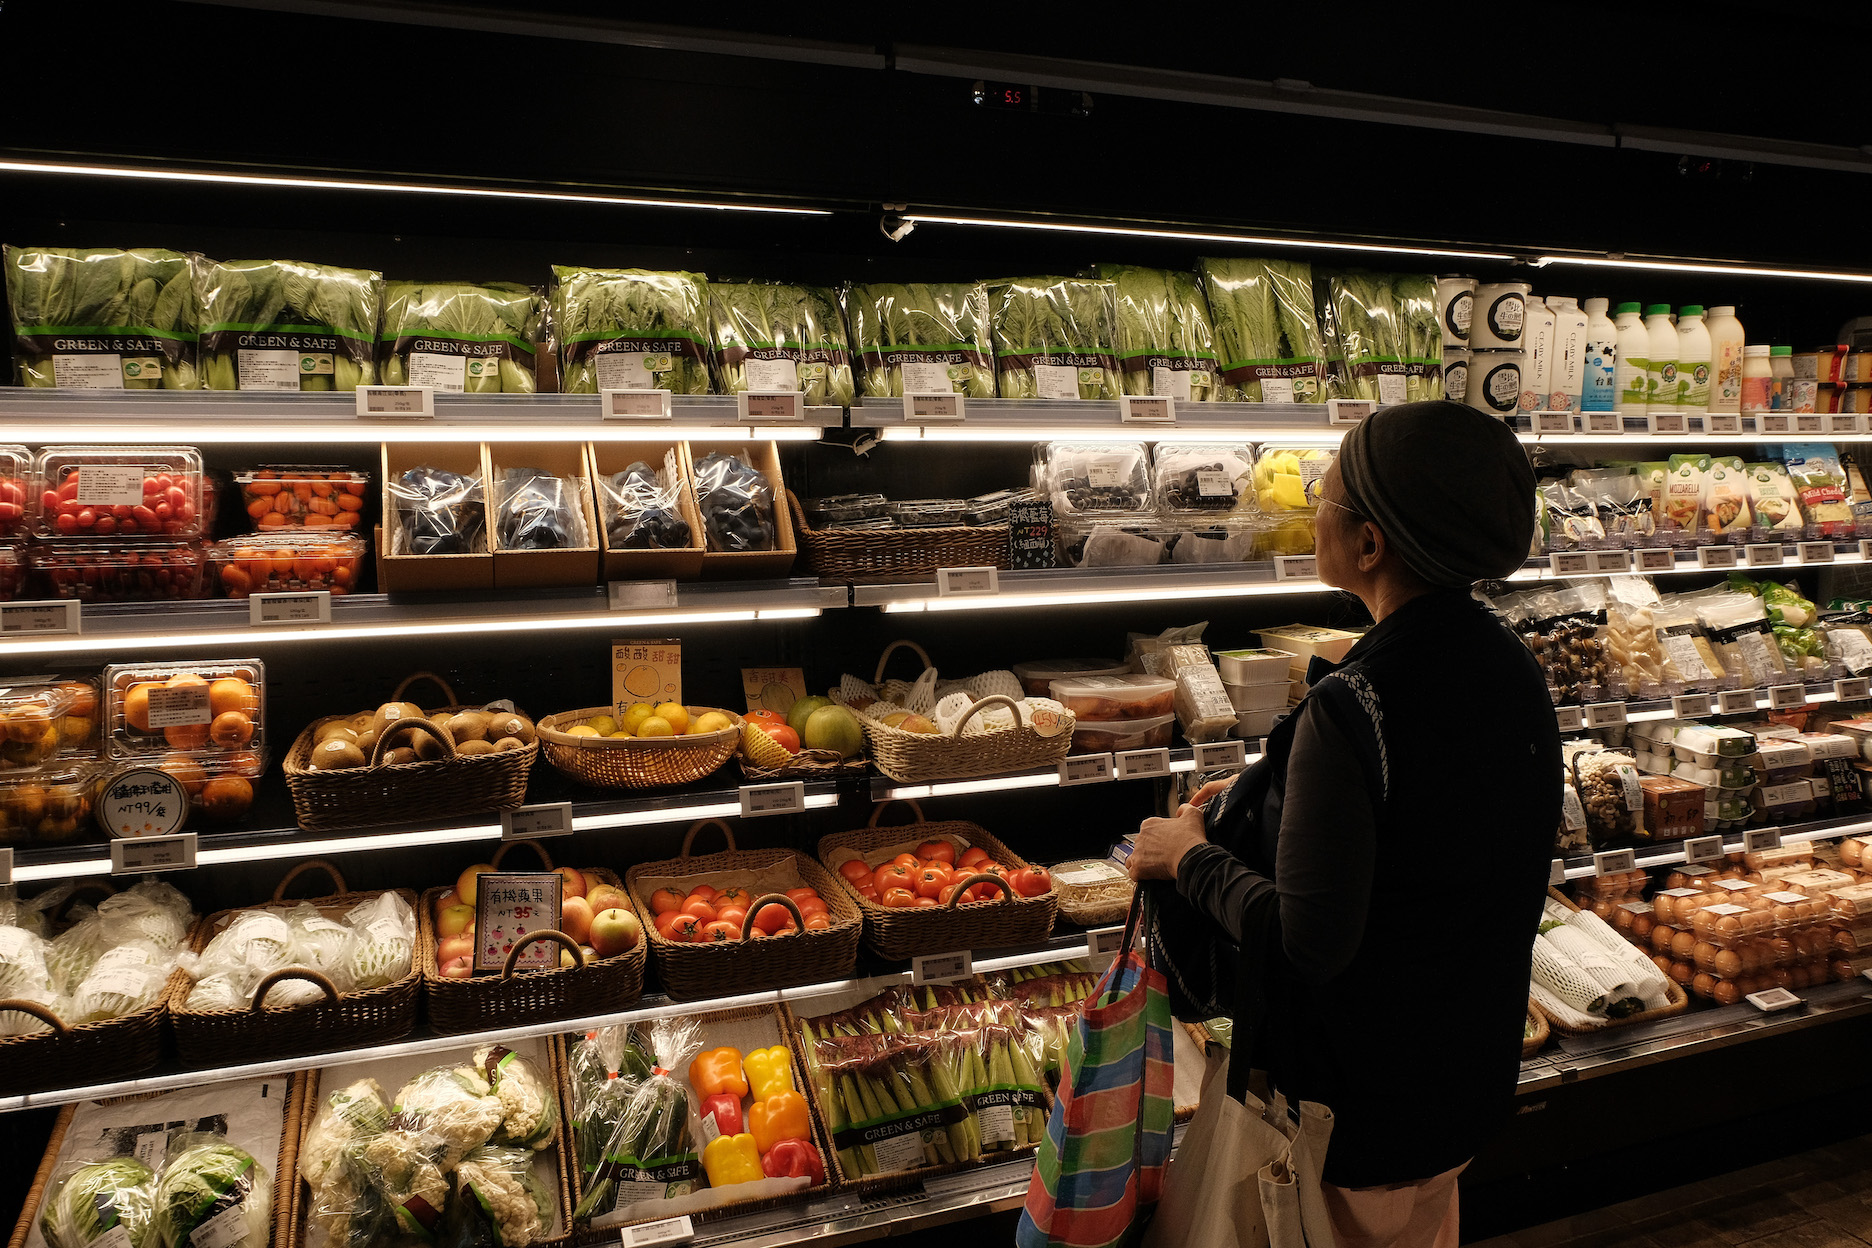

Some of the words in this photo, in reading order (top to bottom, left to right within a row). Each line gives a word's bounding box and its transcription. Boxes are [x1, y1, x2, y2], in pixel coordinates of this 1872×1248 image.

[1005, 90, 1021, 103] 5.5
[54, 339, 109, 351] GREEN
[112, 339, 123, 351] &
[125, 339, 163, 351] SAFE
[238, 335, 285, 348] GREEN
[287, 336, 300, 349] &
[302, 336, 337, 350] SAFE
[414, 340, 459, 353] GREEN
[461, 344, 471, 353] &
[473, 344, 503, 355] SAFE
[598, 341, 641, 352] GREEN
[643, 342, 650, 352] &
[653, 341, 682, 352] SAFE
[753, 350, 790, 360] GREEN
[792, 351, 800, 361] &
[801, 350, 829, 362] SAFE
[887, 353, 923, 364] GREEN
[926, 354, 934, 363] &
[936, 353, 962, 363] SAFE
[1031, 355, 1064, 366] GREEN
[1065, 356, 1073, 366] &
[1073, 356, 1098, 366] SAFE
[1174, 360, 1183, 369] &
[1183, 359, 1206, 369] SAFE
[1255, 367, 1282, 377] GREEN
[1282, 367, 1290, 377] &
[1290, 364, 1314, 376] SAFE
[1567, 360, 1575, 381] MILK
[1669, 484, 1700, 494] MOZZARELLA
[1803, 488, 1821, 499] Mild
[616, 646, 680, 665] 酸酸甜甜
[490, 888, 543, 904] 有機蘋果
[977, 1093, 1010, 1106] GREEN
[864, 1122, 904, 1141] GREEN
[905, 1120, 914, 1130] &
[915, 1113, 941, 1128] SAFE
[619, 1166, 656, 1182] GREEN
[657, 1171, 665, 1180] &
[666, 1165, 690, 1178] SAFE
